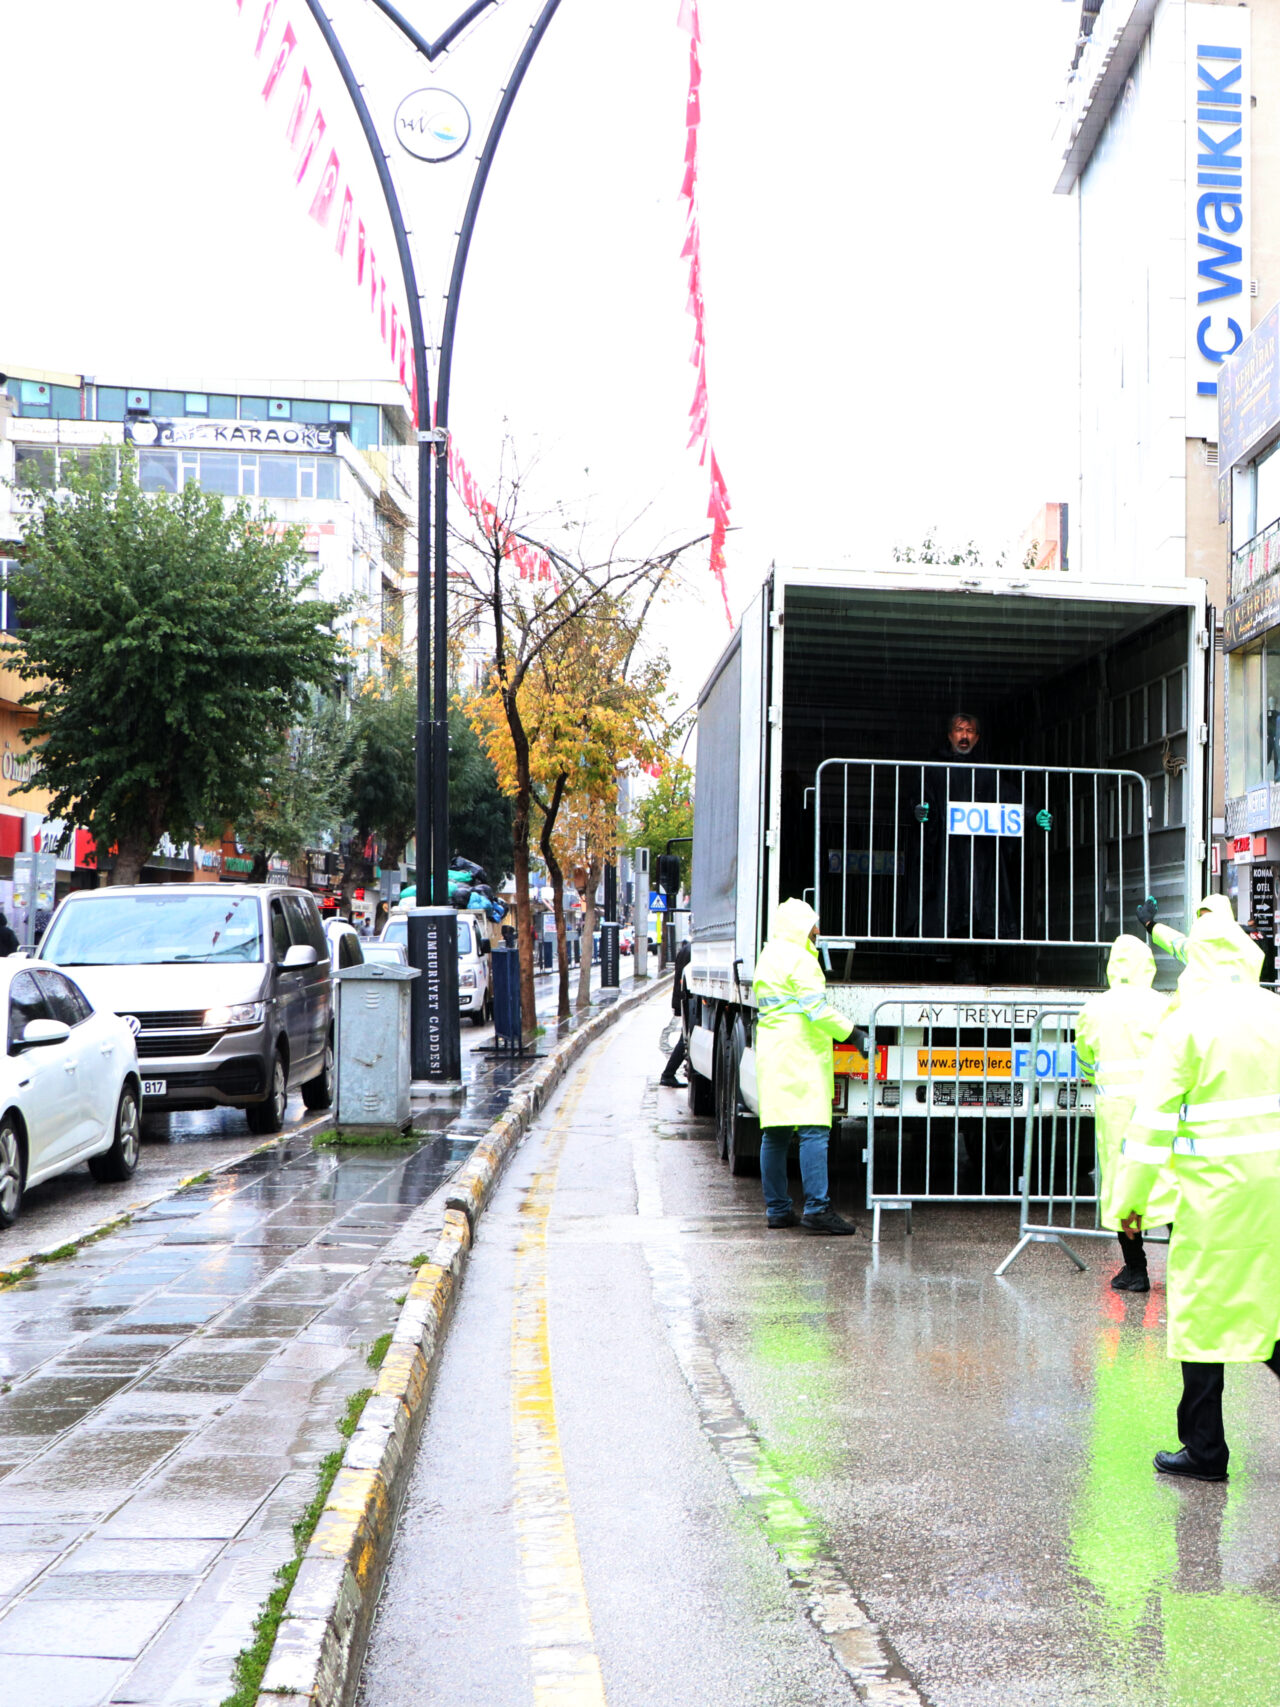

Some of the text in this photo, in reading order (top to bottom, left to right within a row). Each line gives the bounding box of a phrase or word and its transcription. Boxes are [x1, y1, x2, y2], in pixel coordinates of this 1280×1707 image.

[214, 426, 333, 449] KARAOKE
[950, 805, 1022, 834] POLİS
[1256, 883, 1271, 892] OTEL
[427, 923, 442, 1075] CUMHURİYET CADDESİ
[917, 1008, 1038, 1024] AY TREYLER
[1015, 1044, 1086, 1078] POLİ
[144, 1081, 163, 1093] 817
